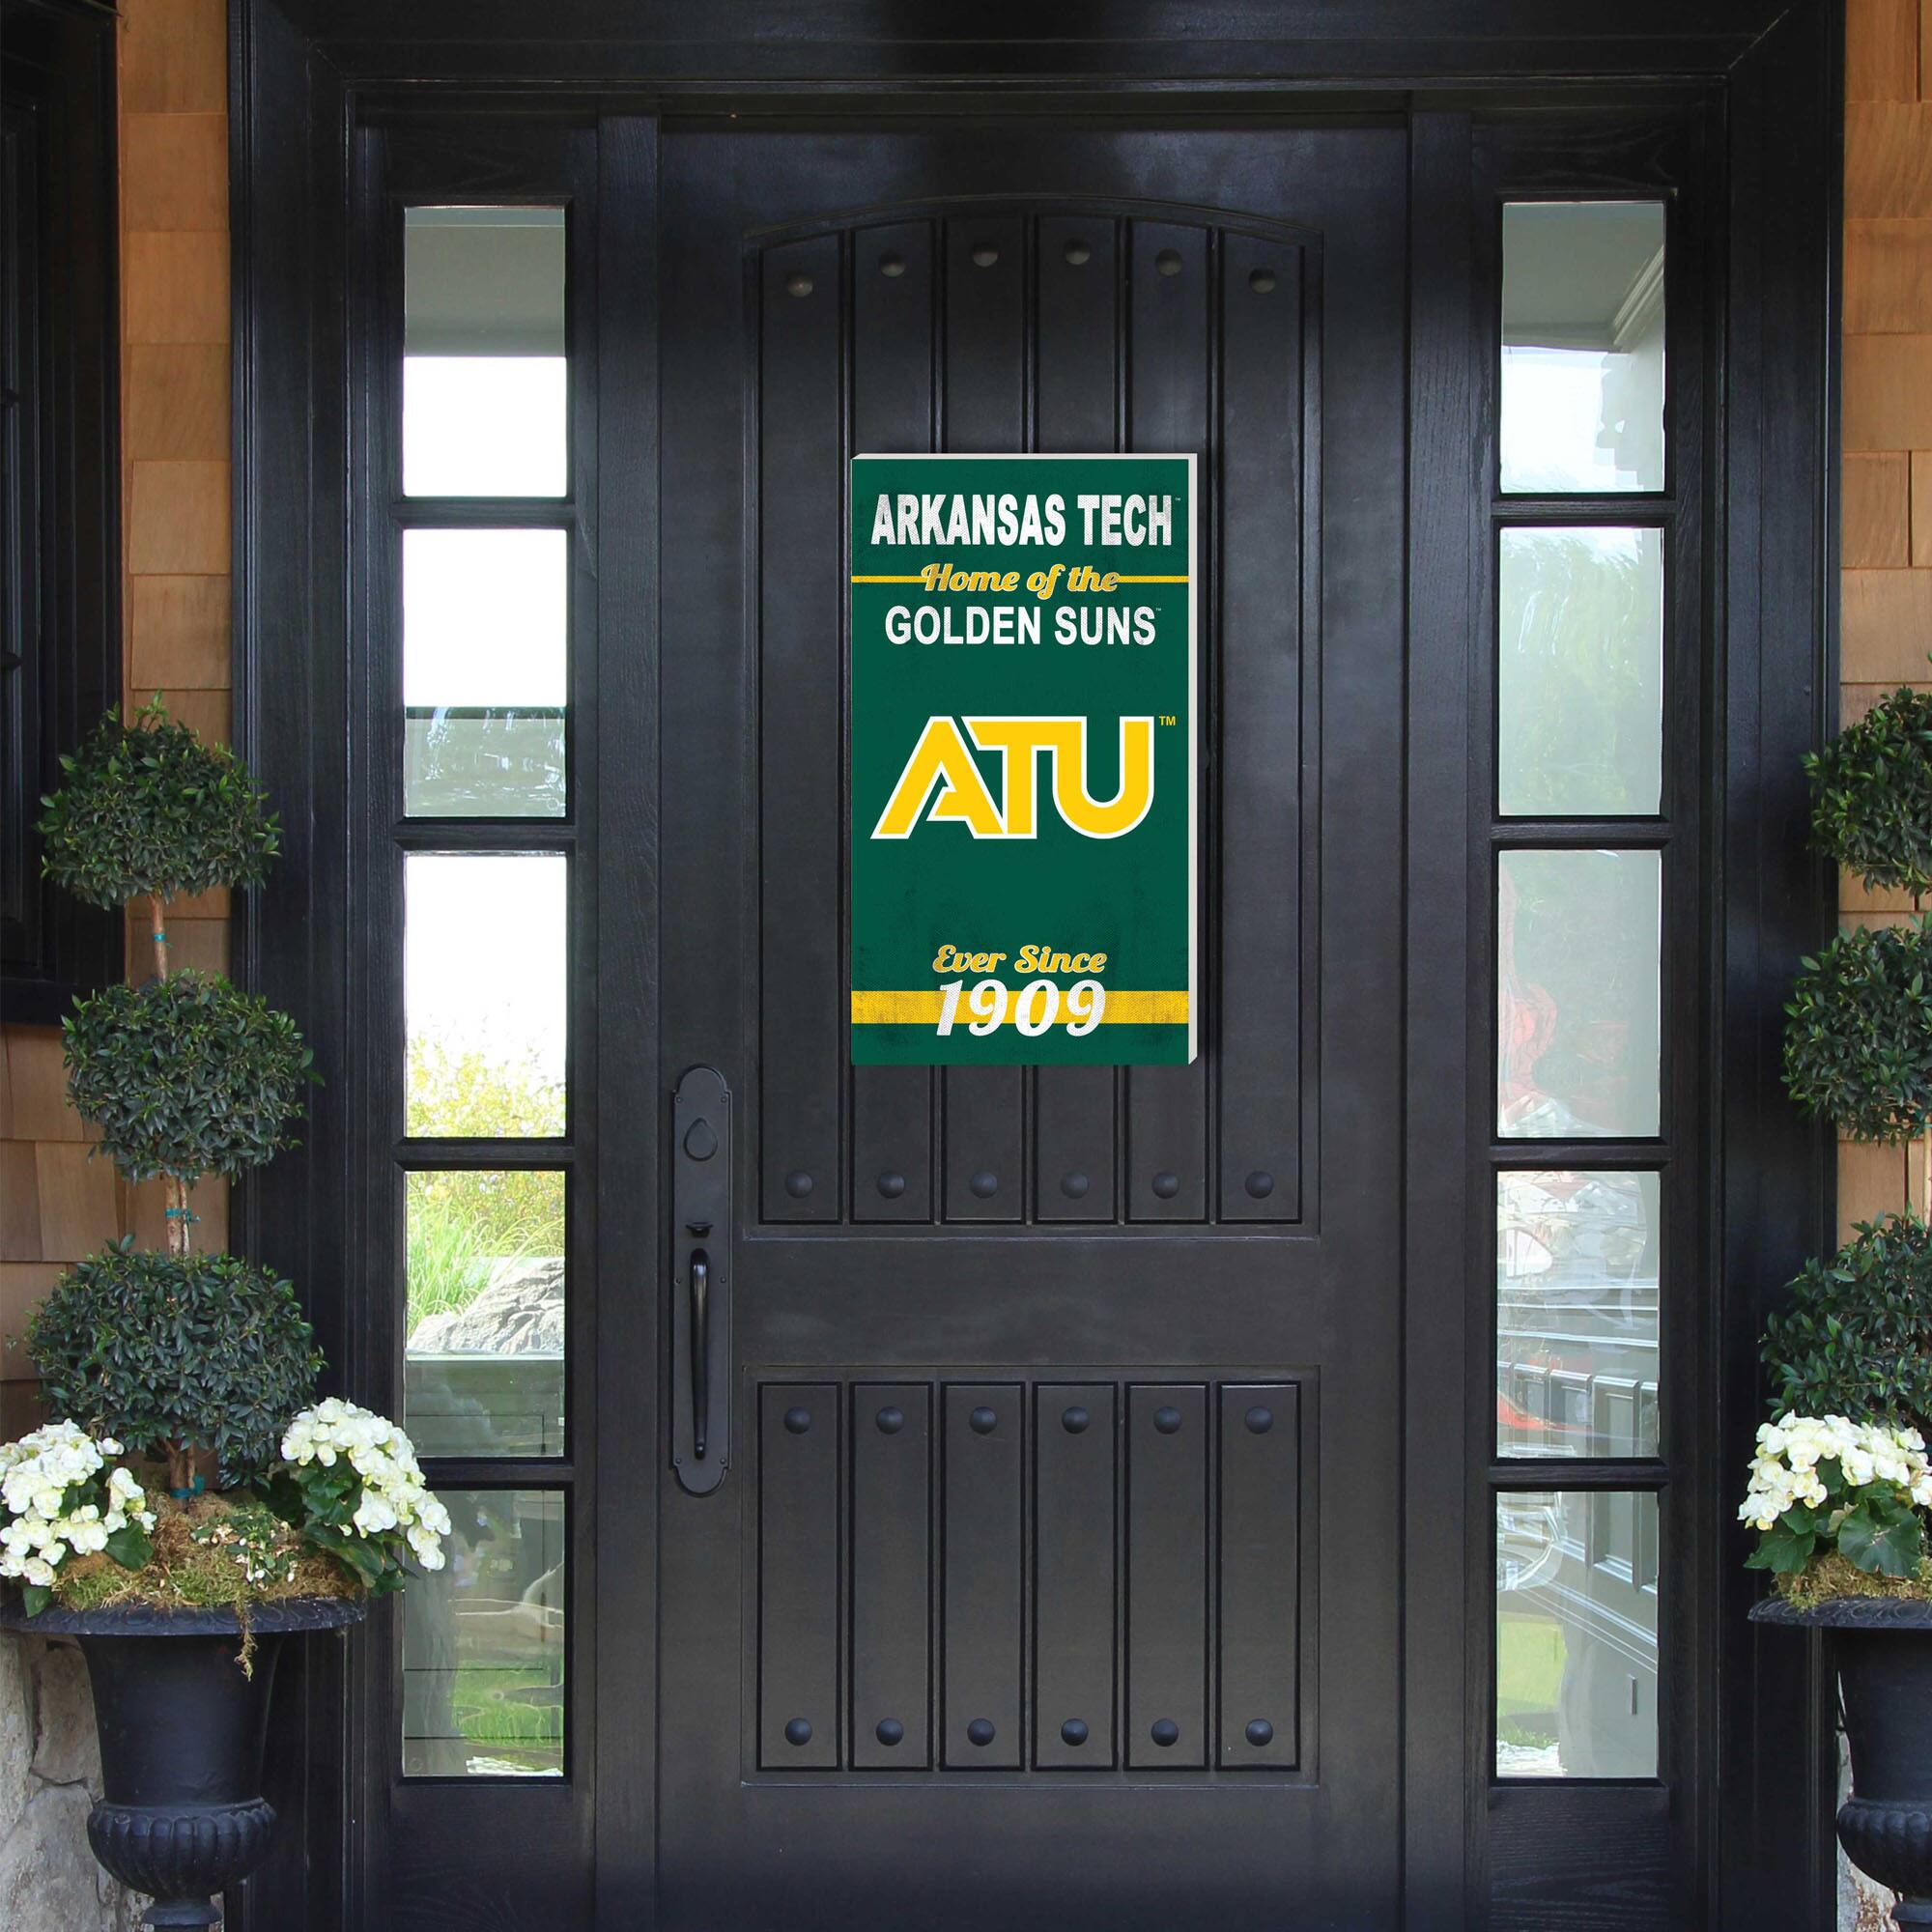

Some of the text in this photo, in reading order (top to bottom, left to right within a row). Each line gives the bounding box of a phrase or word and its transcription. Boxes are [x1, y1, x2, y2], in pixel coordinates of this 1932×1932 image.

[871, 494, 1172, 546] ARKANSAS TECH
[921, 563, 1121, 600] Home of the
[885, 606, 1156, 645] GOLDEN SUNS
[869, 716, 1154, 839] ATU
[932, 944, 1107, 974] Ever Since
[936, 979, 1106, 1037] 1909
